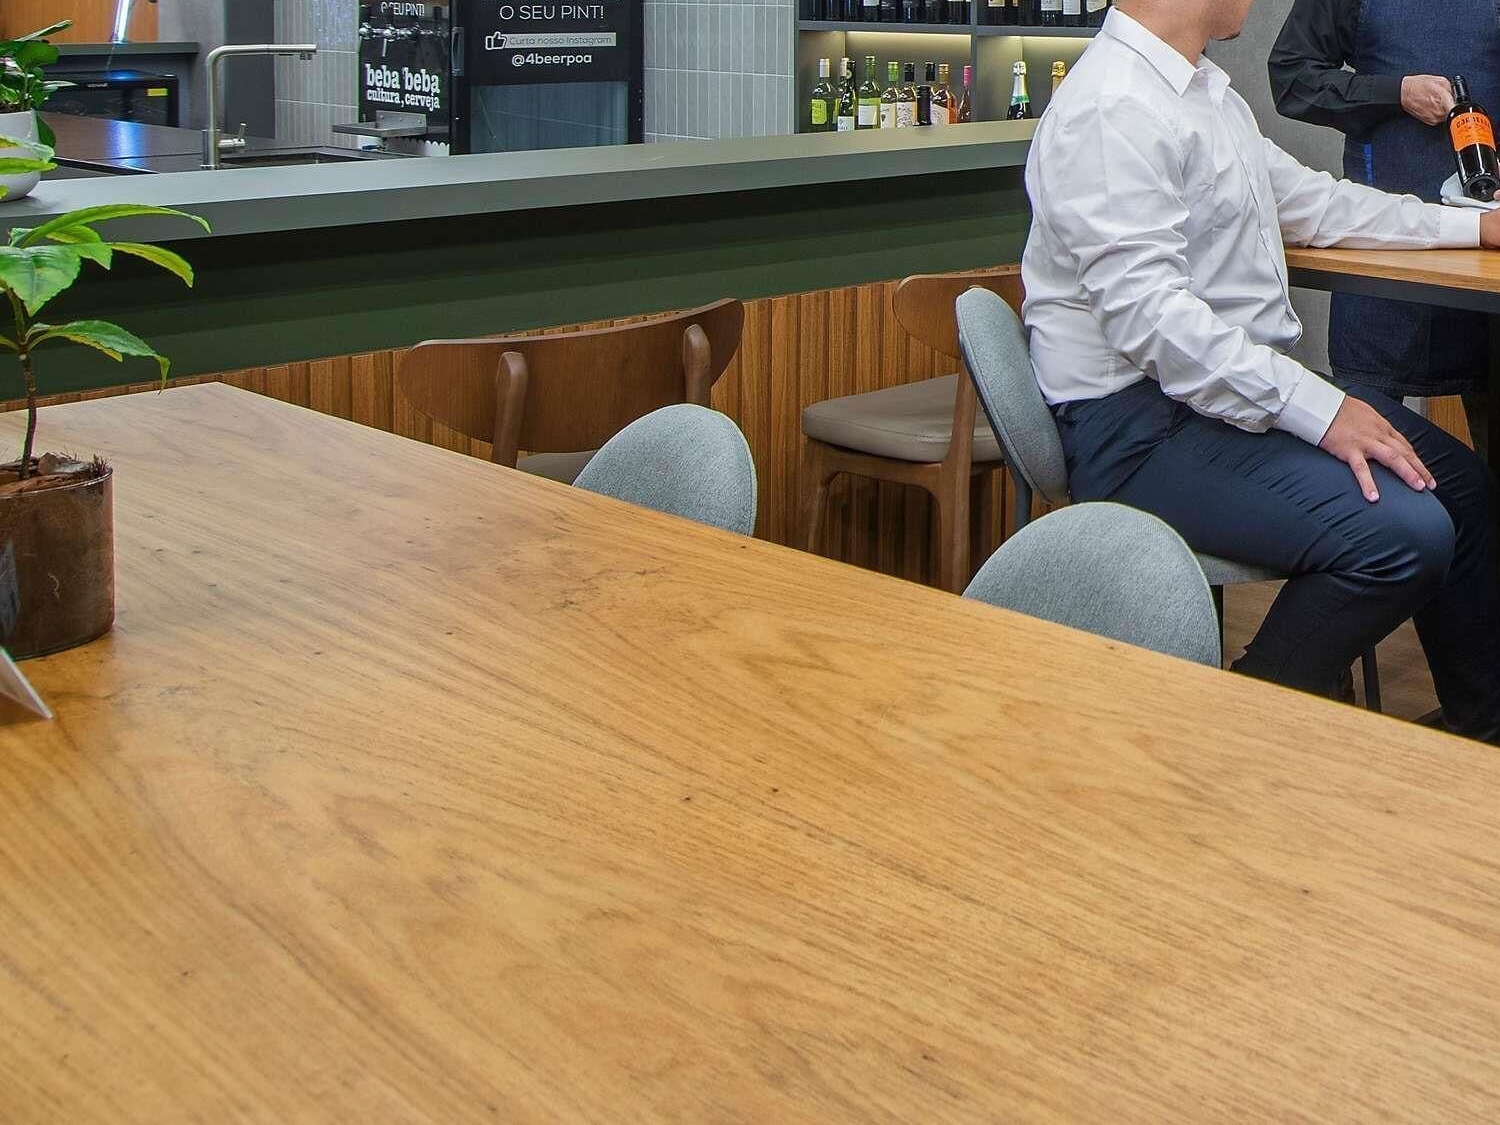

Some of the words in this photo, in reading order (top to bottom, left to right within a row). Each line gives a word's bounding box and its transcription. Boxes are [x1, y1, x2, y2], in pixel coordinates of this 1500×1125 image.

[500, 5, 514, 19] O
[519, 5, 555, 19] SEU
[561, 5, 604, 19] PINT!
[538, 35, 564, 45] nosso
[511, 53, 592, 66] @4beerpoa
[365, 63, 400, 88] beba
[402, 66, 440, 93] beba
[405, 93, 440, 111] cerveja
